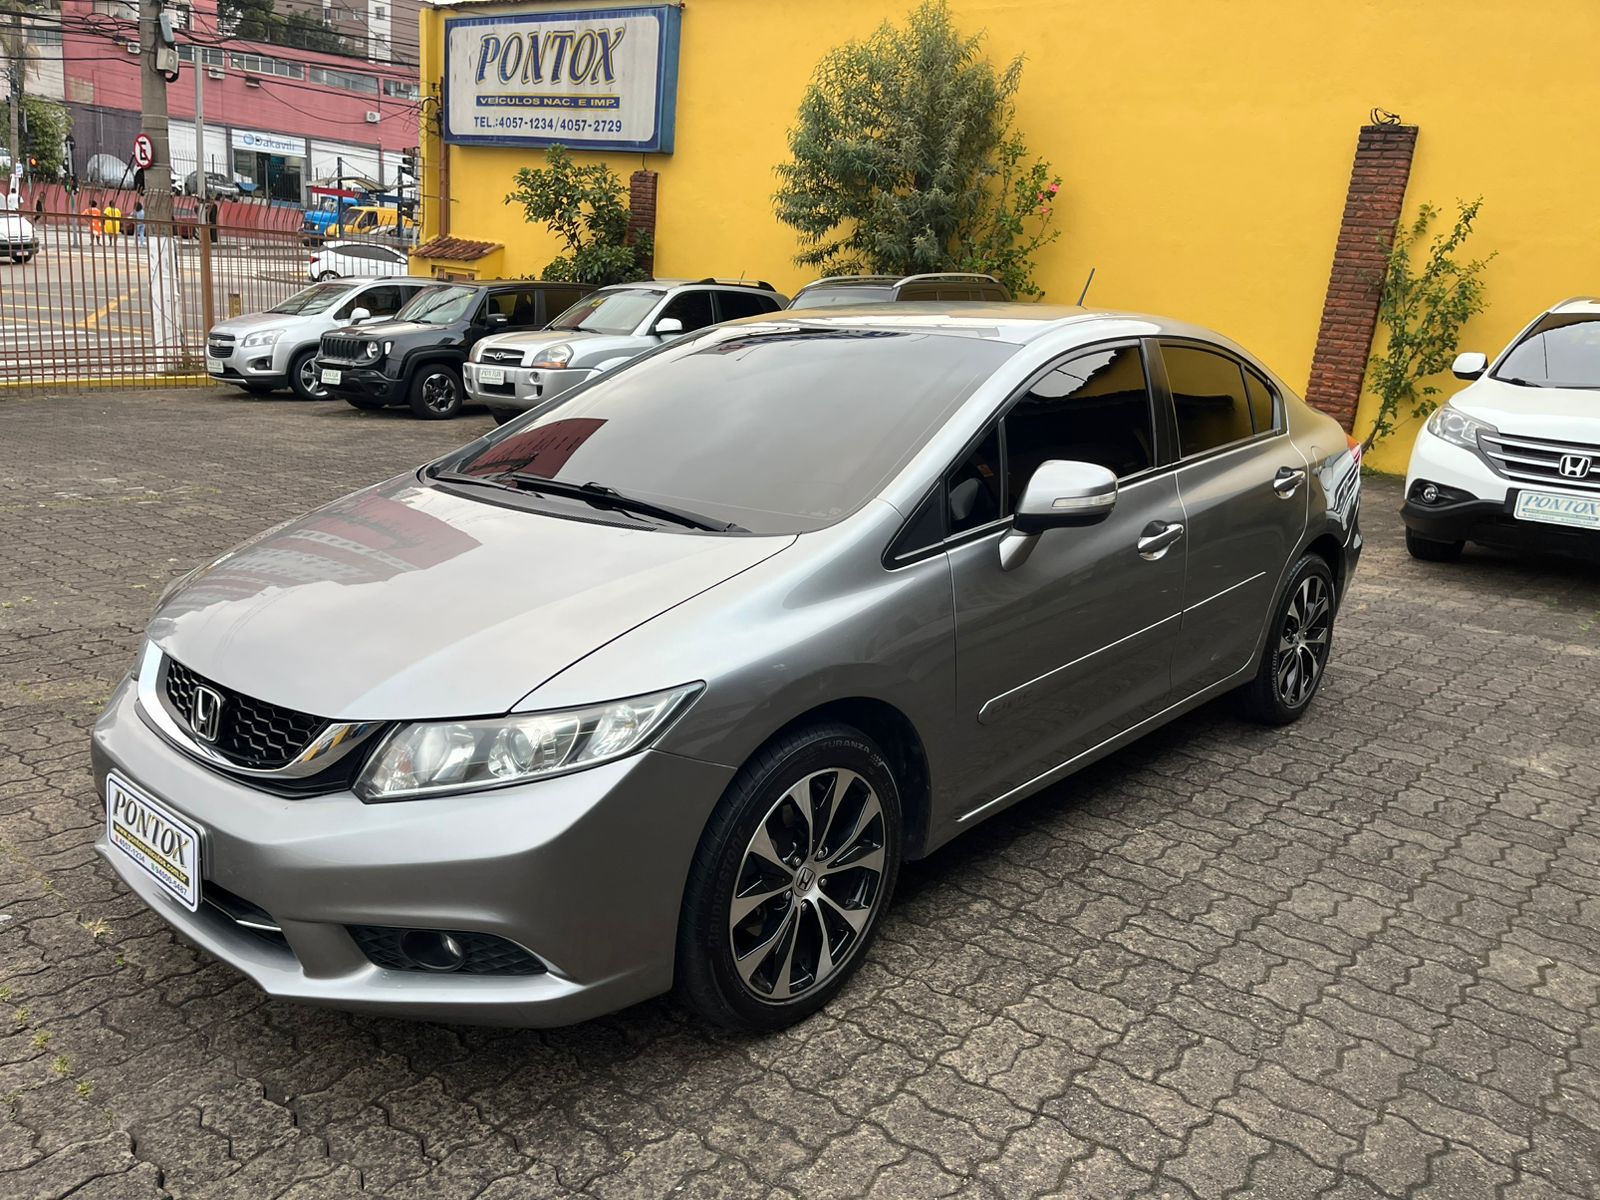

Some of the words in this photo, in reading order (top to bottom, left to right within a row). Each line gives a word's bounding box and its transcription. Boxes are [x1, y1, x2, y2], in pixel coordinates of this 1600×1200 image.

[475, 26, 627, 86] PONTOX
[544, 98, 574, 106] NAC.
[591, 99, 617, 107] IMP.
[1524, 496, 1599, 514] PONTOX
[113, 789, 190, 869] PONTOX
